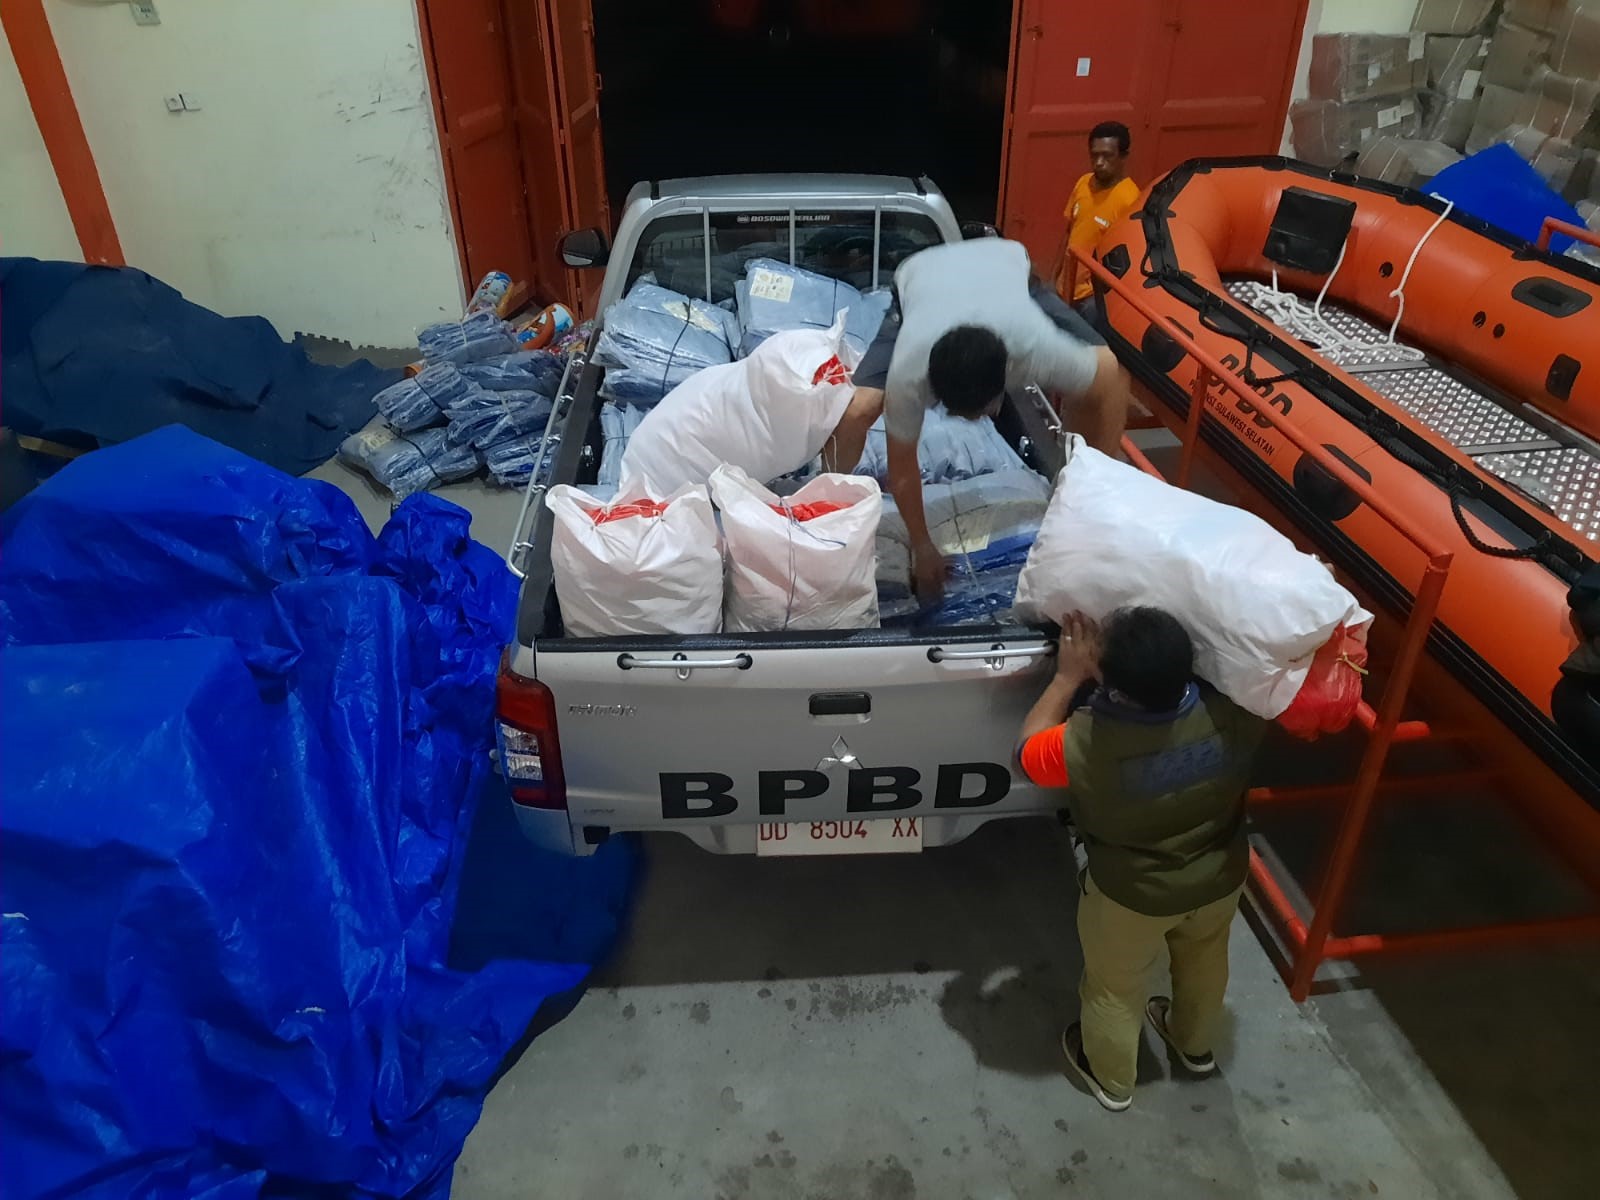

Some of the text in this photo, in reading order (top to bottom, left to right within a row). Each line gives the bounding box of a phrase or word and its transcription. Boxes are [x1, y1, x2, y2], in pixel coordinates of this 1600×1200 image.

[1215, 402, 1248, 433] SULAWESI
[1245, 427, 1276, 457] SELATAN
[659, 762, 1011, 819] BPBD
[760, 817, 919, 841] DD 8504 XX
